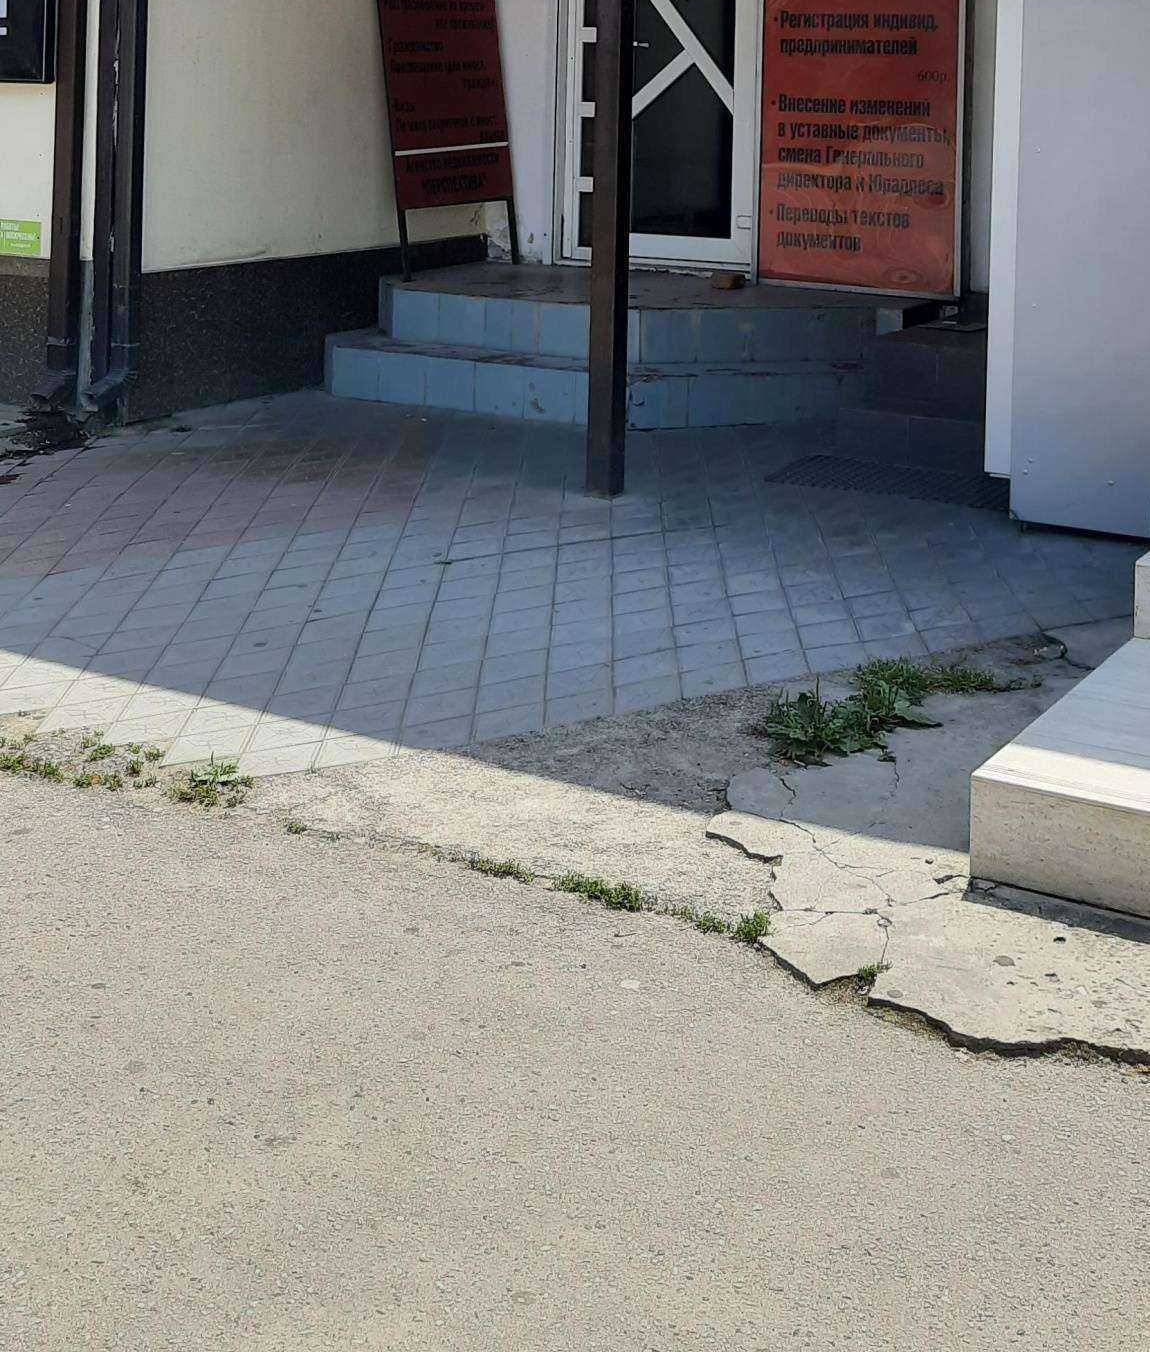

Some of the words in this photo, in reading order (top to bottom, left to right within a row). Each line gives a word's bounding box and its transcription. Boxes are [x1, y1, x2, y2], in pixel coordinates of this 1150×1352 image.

[780, 10, 869, 34] Регистрация
[780, 36, 918, 57] предпринимателей
[778, 93, 846, 114] Внесение
[850, 98, 931, 117] изменений
[778, 123, 784, 138] в
[790, 122, 858, 142] уставные
[778, 147, 821, 164] смена
[777, 173, 852, 193] директора
[777, 203, 848, 227] Переводы
[852, 208, 910, 229] текстов
[777, 231, 862, 252] документов
